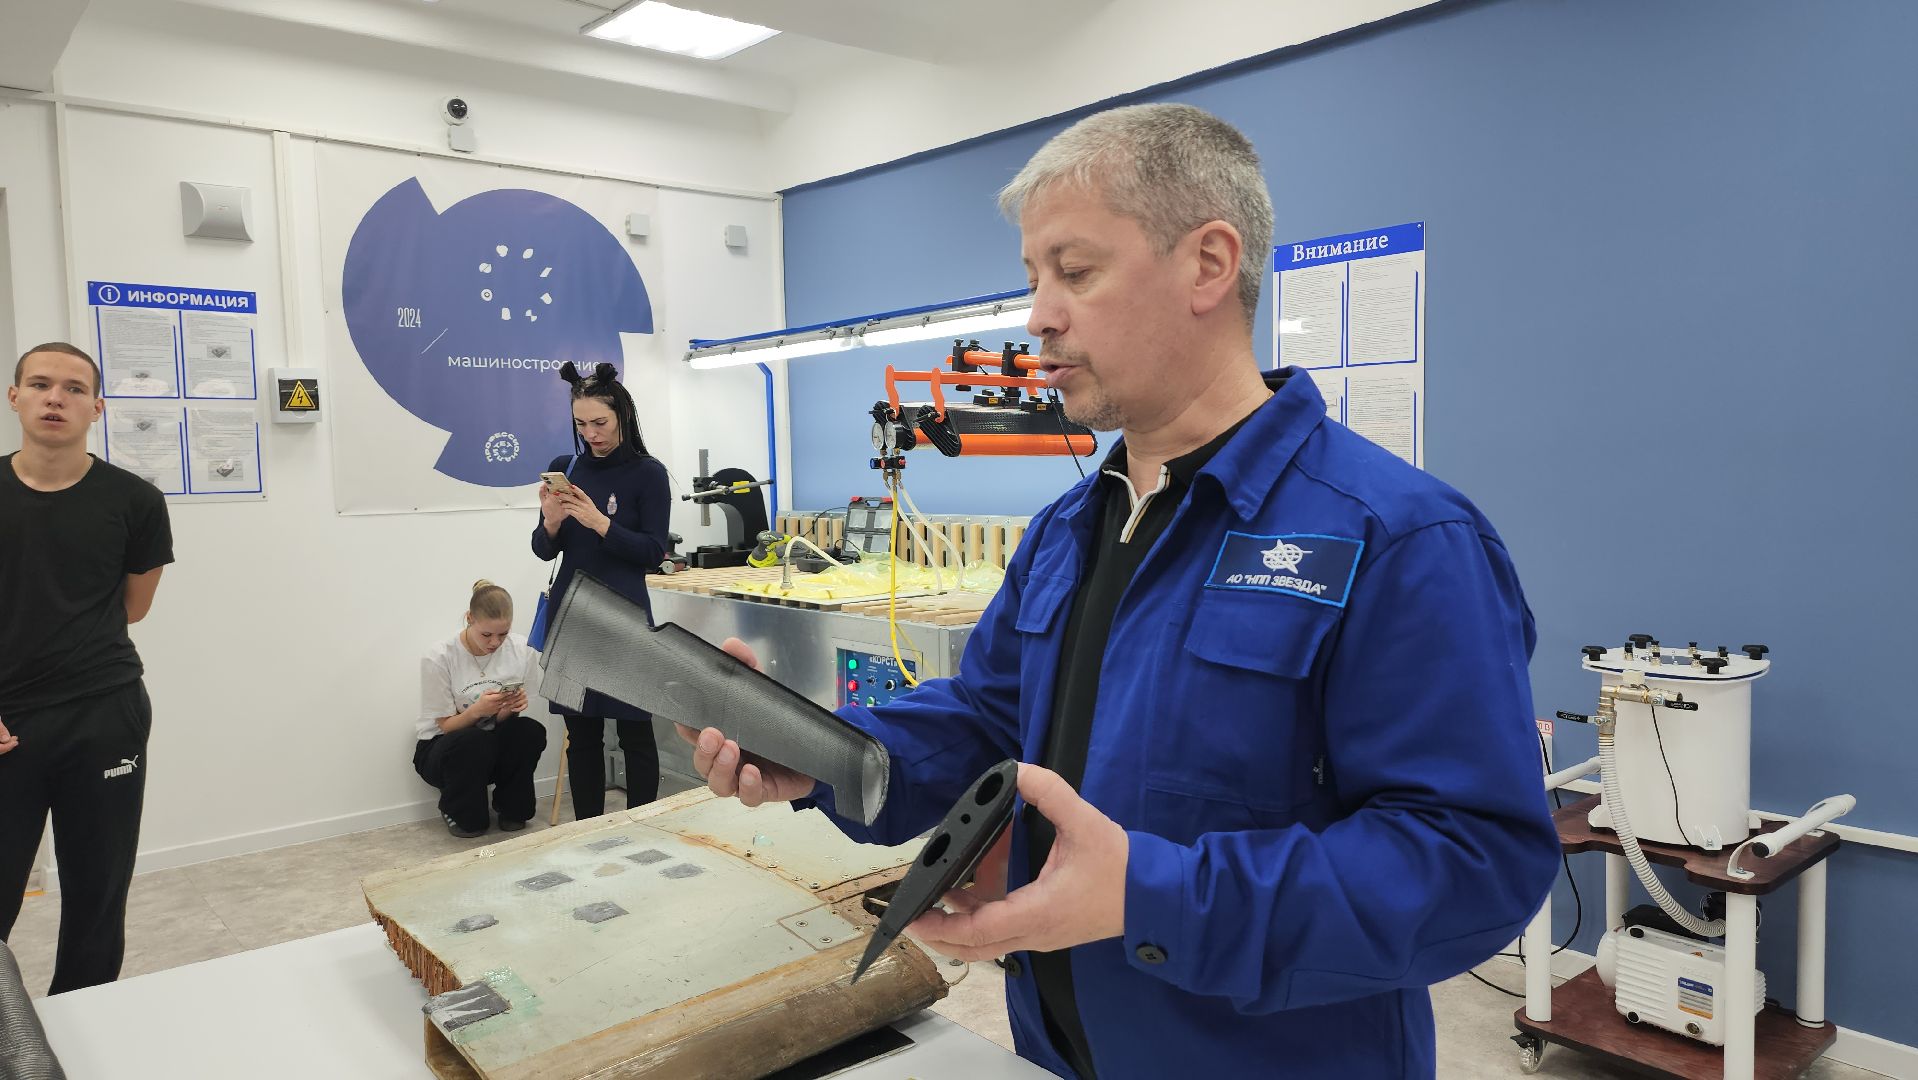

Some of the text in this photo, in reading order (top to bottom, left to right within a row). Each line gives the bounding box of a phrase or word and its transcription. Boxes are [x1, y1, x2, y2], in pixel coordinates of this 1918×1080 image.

[1292, 235, 1389, 262] Внимание
[128, 290, 249, 309] ИНФОРМАЦИЯ
[398, 307, 422, 328] 2024
[1226, 573, 1244, 584] АО
[104, 763, 133, 779] PUMA
